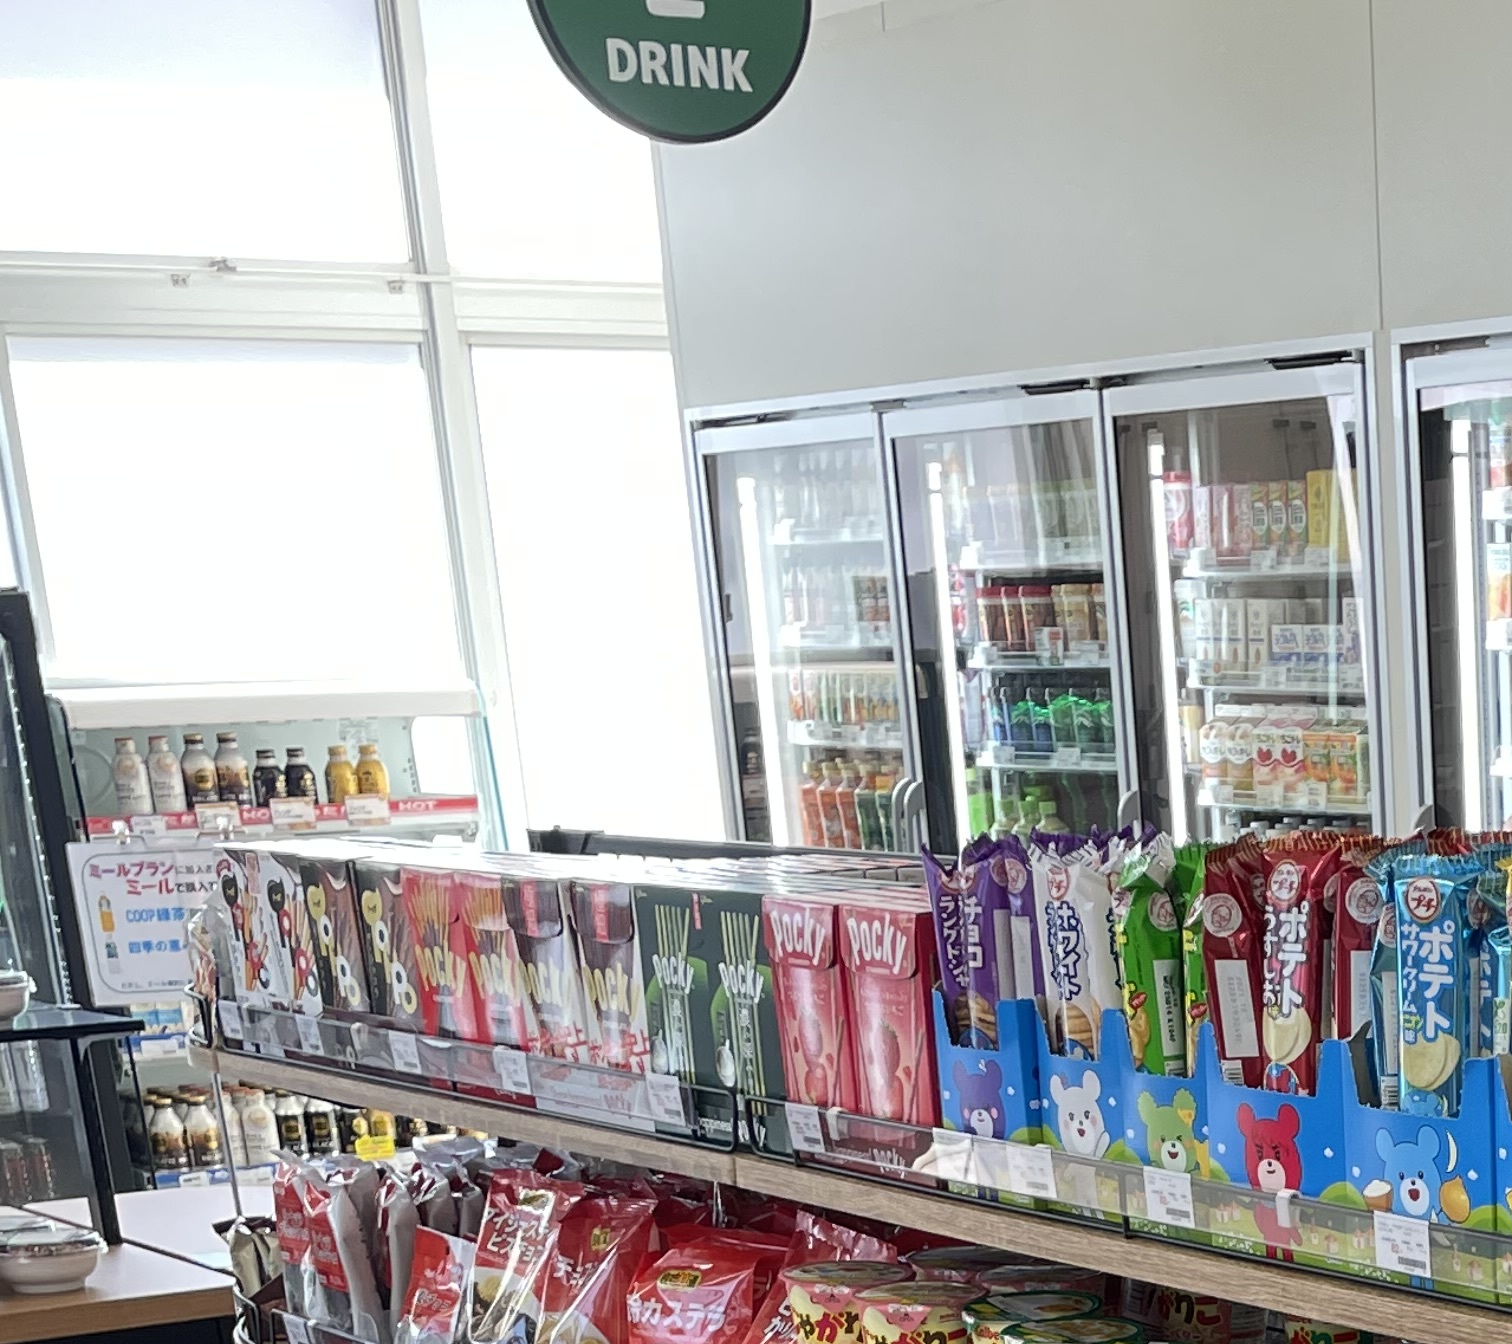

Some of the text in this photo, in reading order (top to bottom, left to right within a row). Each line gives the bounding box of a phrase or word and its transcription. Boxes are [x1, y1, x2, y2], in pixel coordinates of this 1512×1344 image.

[605, 37, 753, 93] DRINK
[399, 801, 438, 811] HOT
[960, 896, 984, 968] チョコ
[1278, 901, 1309, 1015] ポテト
[1419, 919, 1455, 1039] ポテト
